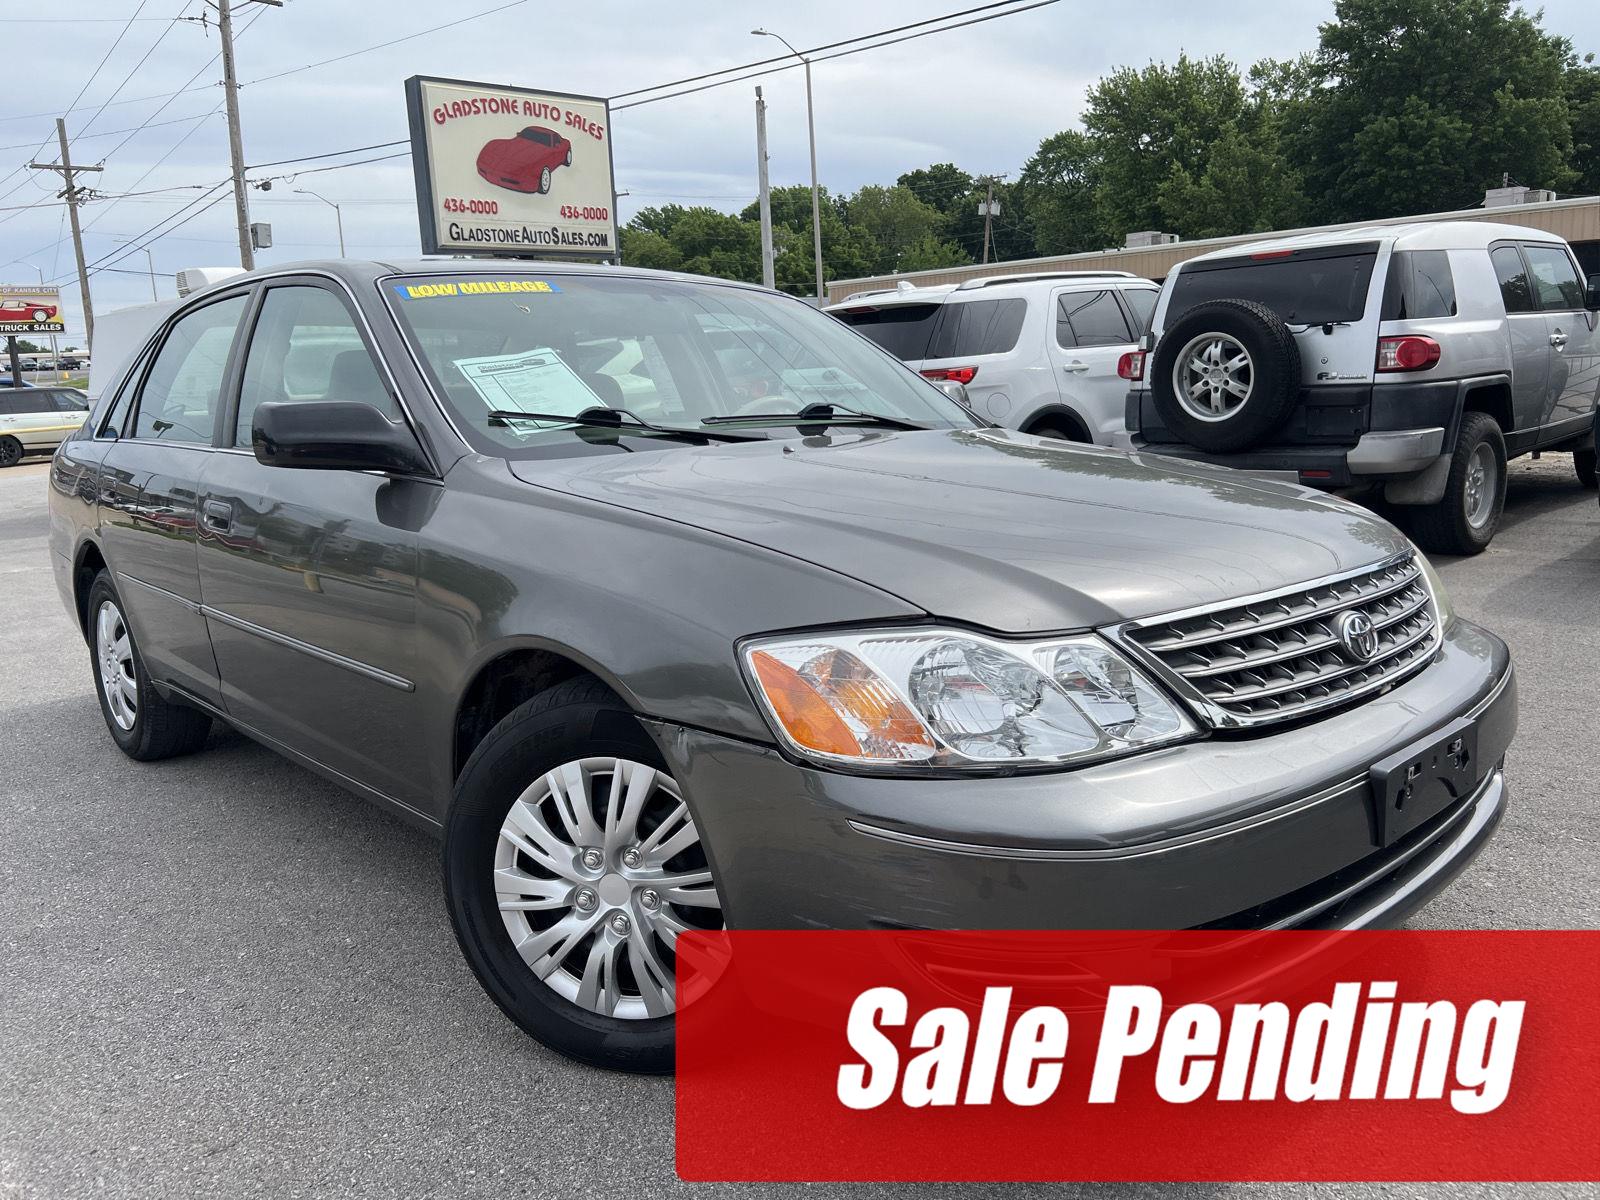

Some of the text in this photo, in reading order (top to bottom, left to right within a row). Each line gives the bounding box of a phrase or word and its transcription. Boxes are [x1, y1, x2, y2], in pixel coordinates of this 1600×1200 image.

[433, 97, 604, 141] GLADSTONE AUTO SALES
[444, 198, 498, 215] 436-0000
[560, 205, 608, 221] 436-0000
[406, 281, 553, 299] LOW MILEAGE
